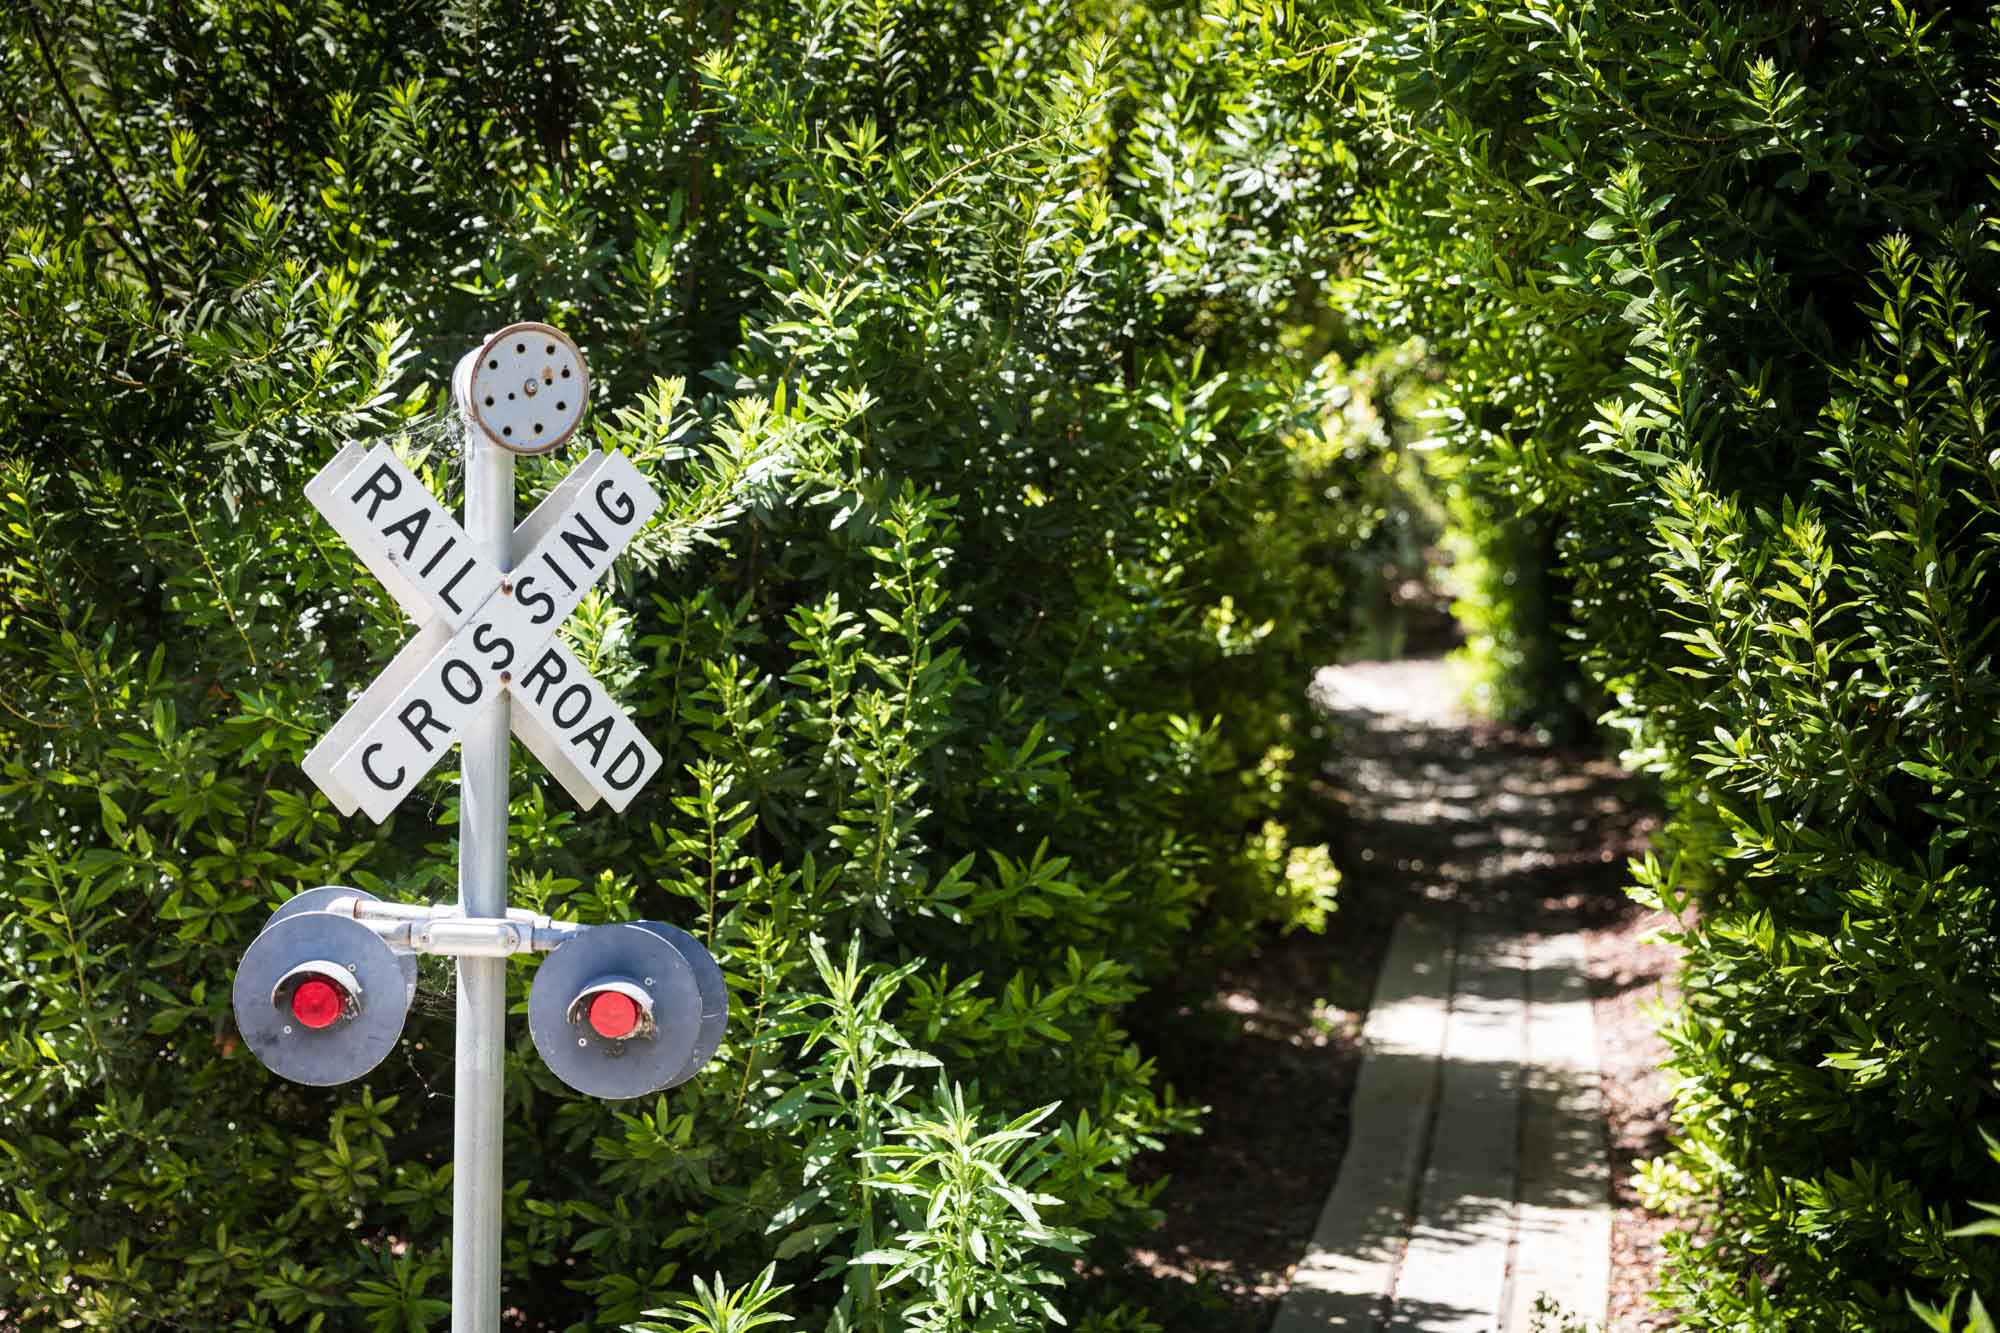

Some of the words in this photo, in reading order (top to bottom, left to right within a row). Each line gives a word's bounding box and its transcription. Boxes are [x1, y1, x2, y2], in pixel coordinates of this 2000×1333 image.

[351, 462, 476, 615] RAIL
[520, 647, 646, 791] ROAD
[361, 479, 636, 791] CROSSING
